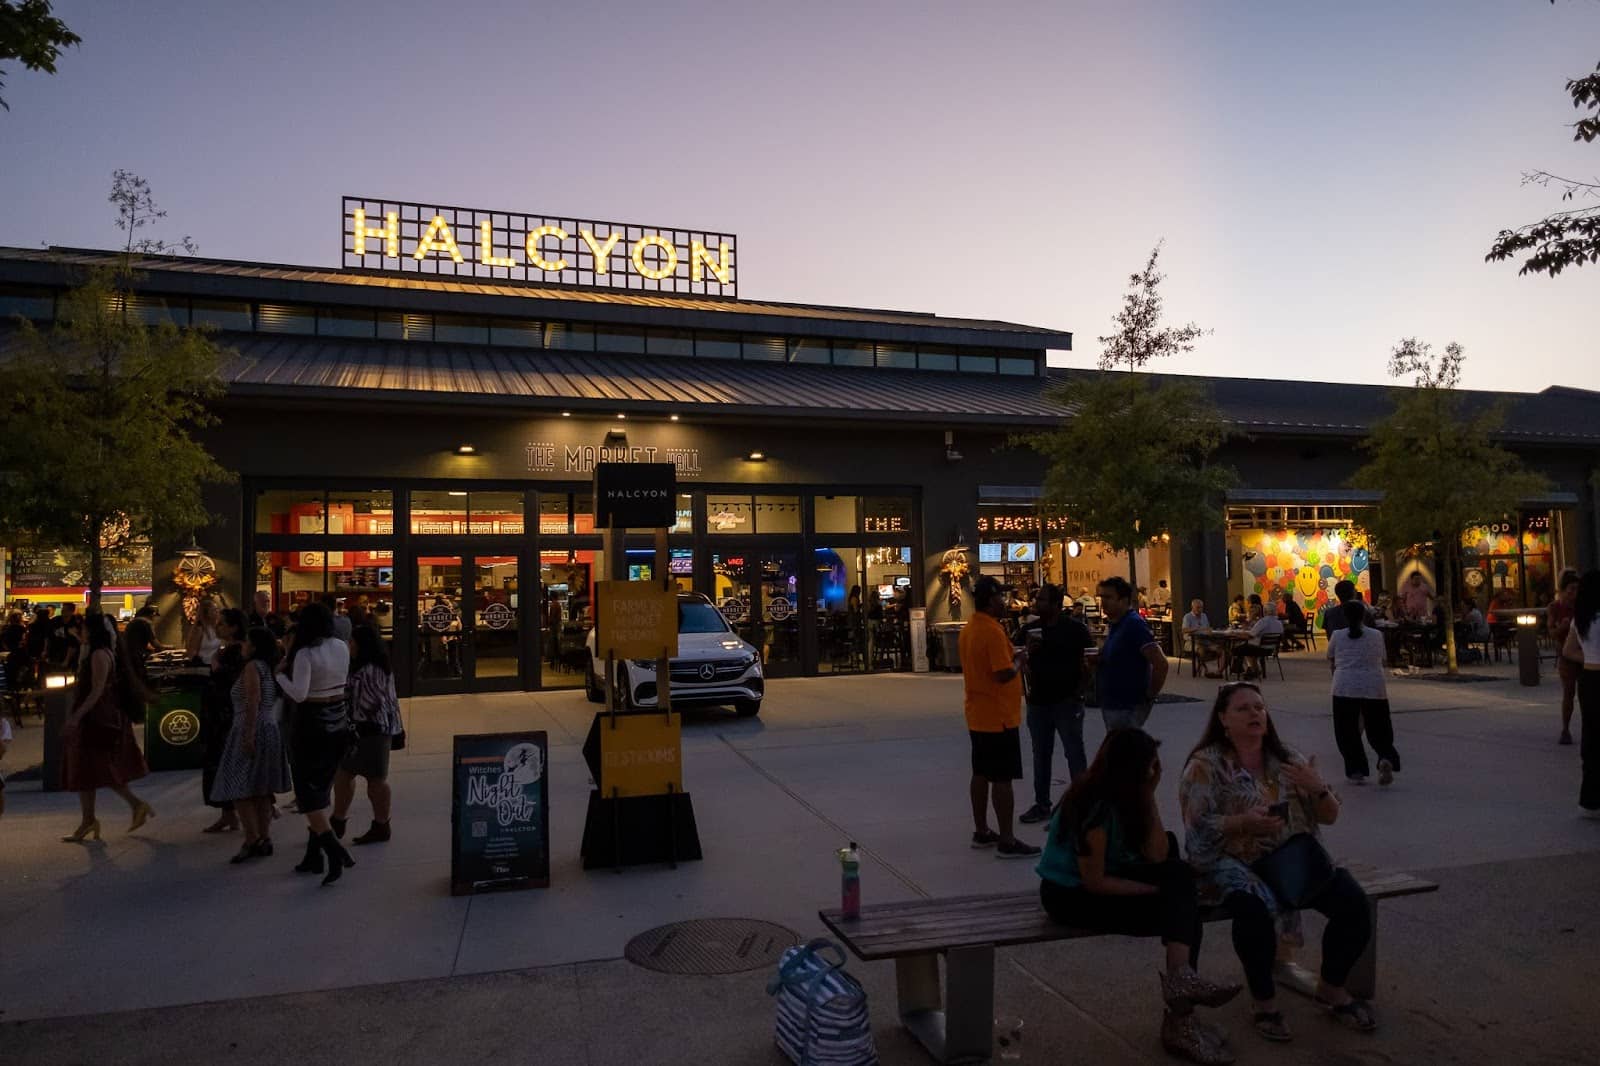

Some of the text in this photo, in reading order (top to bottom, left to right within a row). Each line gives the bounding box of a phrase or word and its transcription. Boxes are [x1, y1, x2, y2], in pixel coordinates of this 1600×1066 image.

[353, 208, 730, 285] HALCYON
[526, 445, 702, 472] THE MARKET HALL
[607, 489, 668, 499] HALCYON
[465, 772, 523, 808] Night
[497, 794, 537, 826] Out
